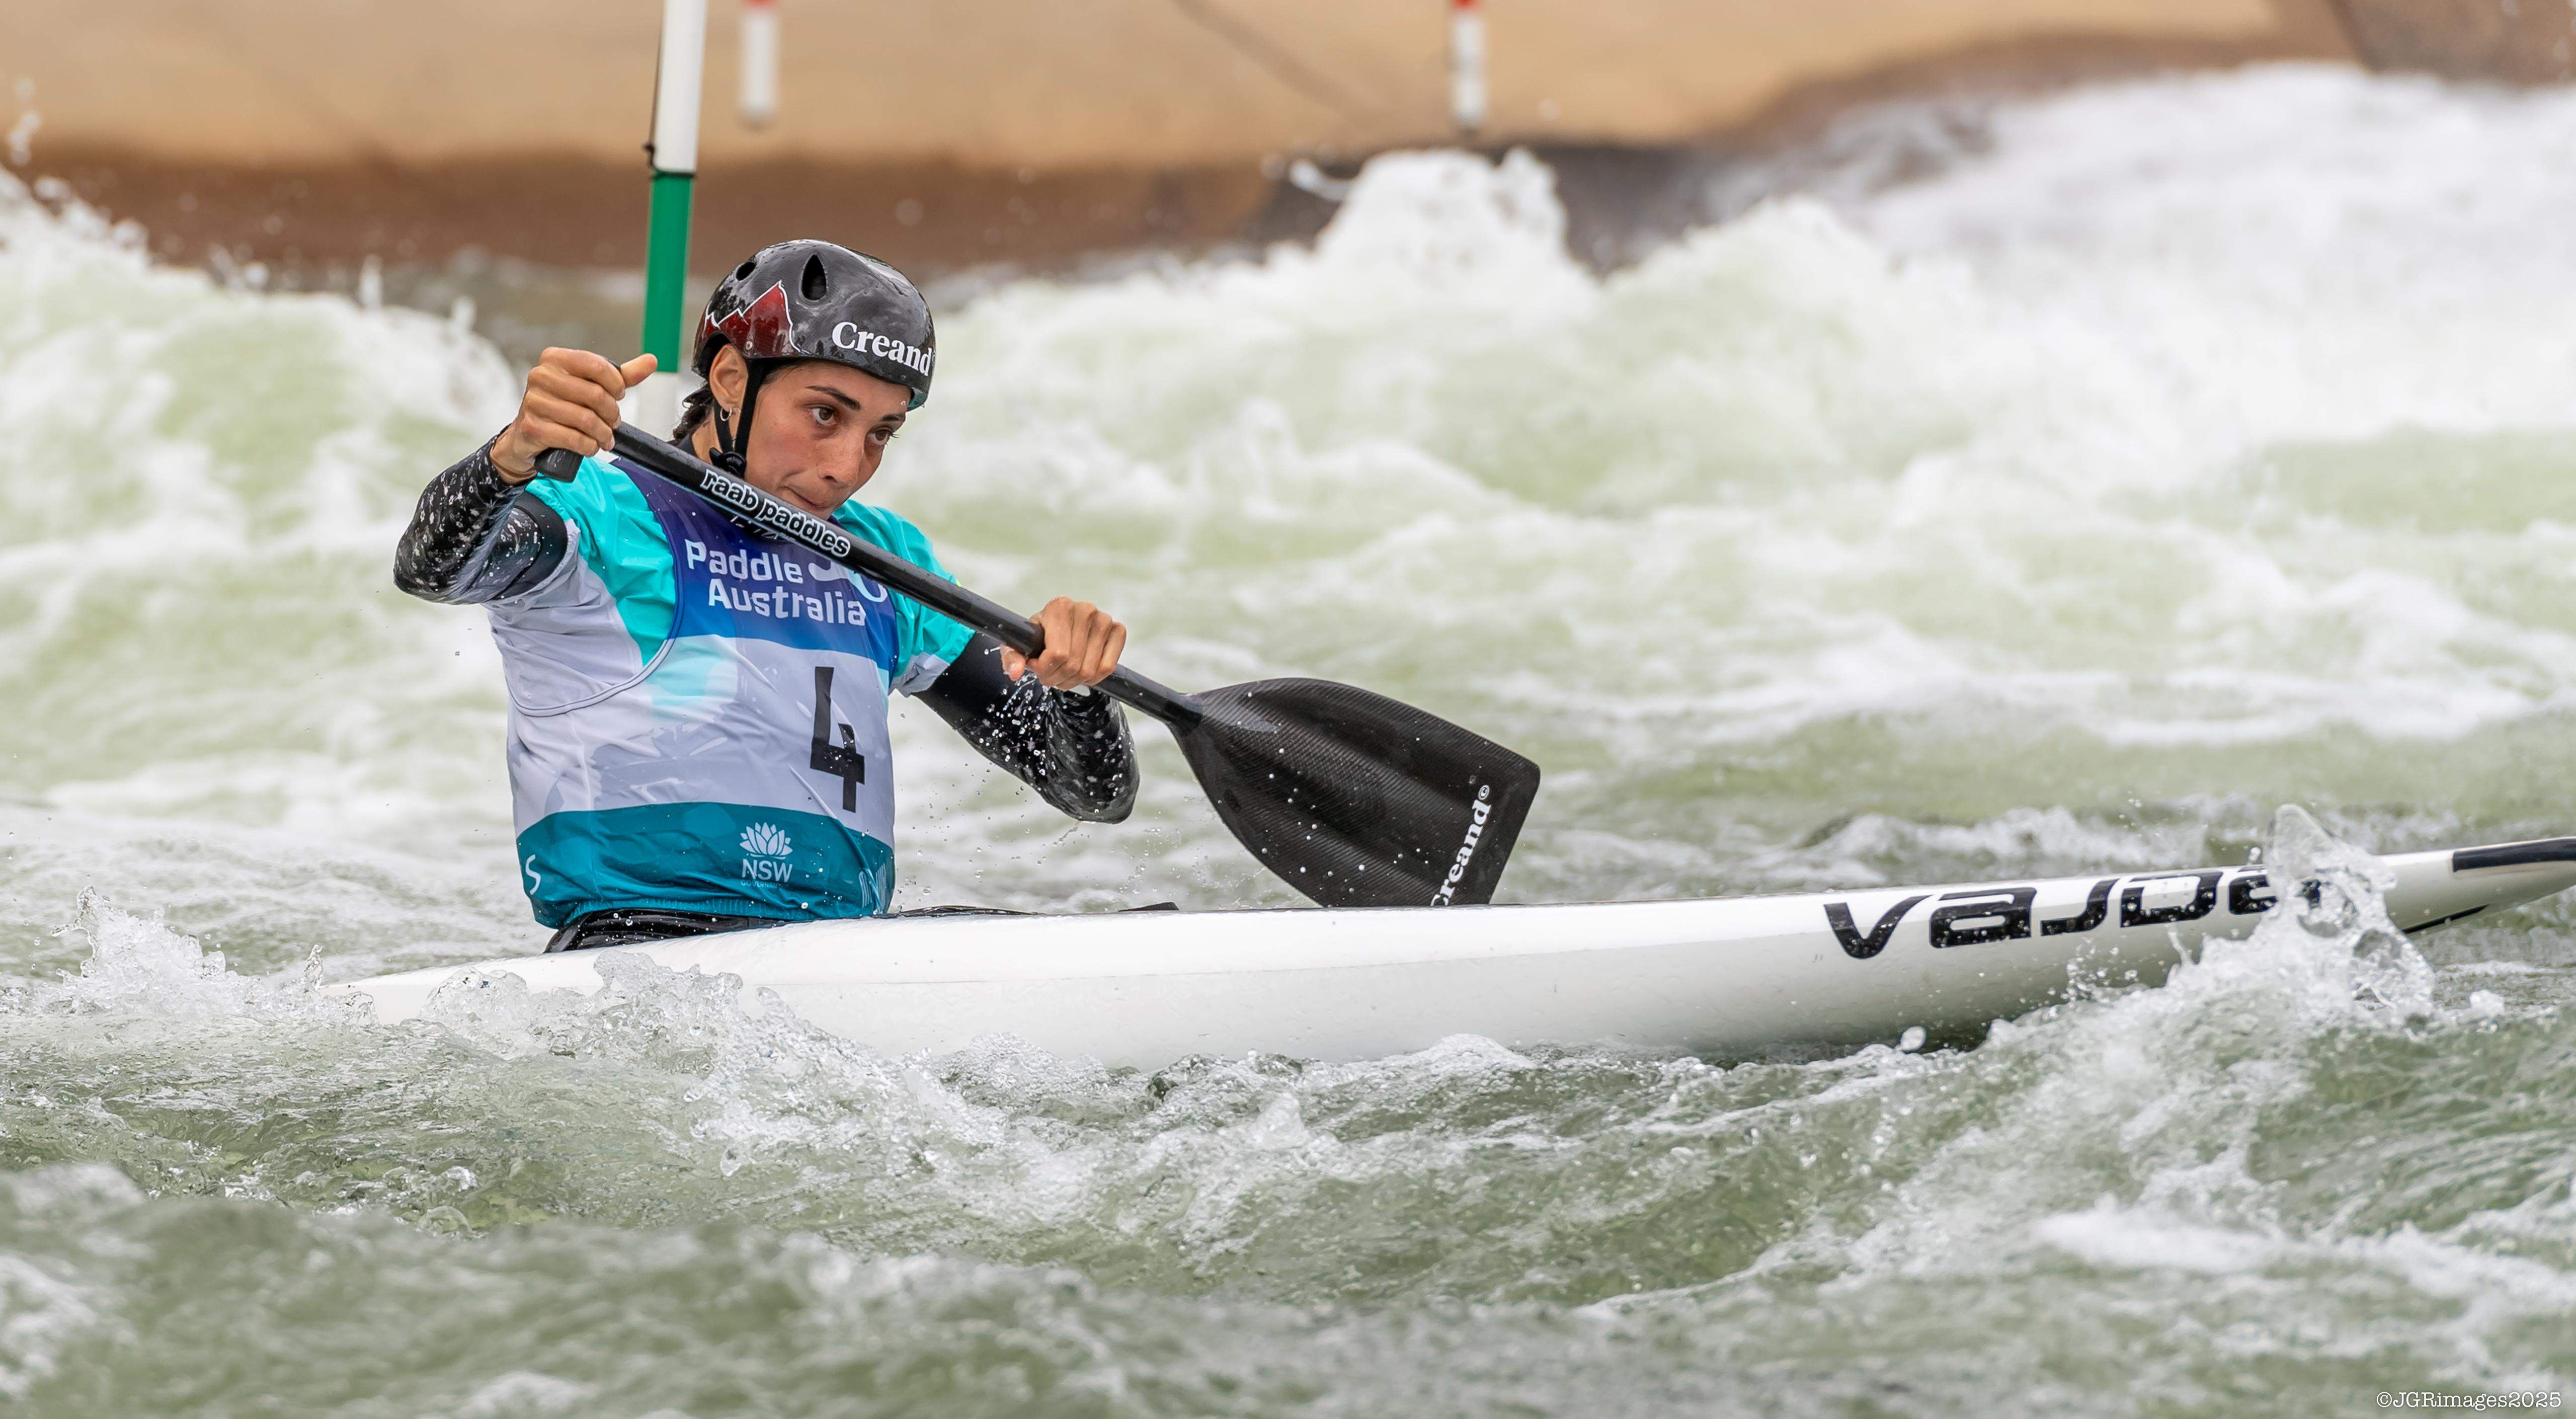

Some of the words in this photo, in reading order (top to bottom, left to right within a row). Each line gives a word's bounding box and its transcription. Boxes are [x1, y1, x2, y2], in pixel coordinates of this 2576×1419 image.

[700, 469, 759, 511] raab
[755, 498, 851, 558] paddles
[684, 538, 804, 584] Paddle
[708, 578, 867, 626] Australia
[810, 666, 865, 813] 4
[742, 858, 793, 883] NSW
